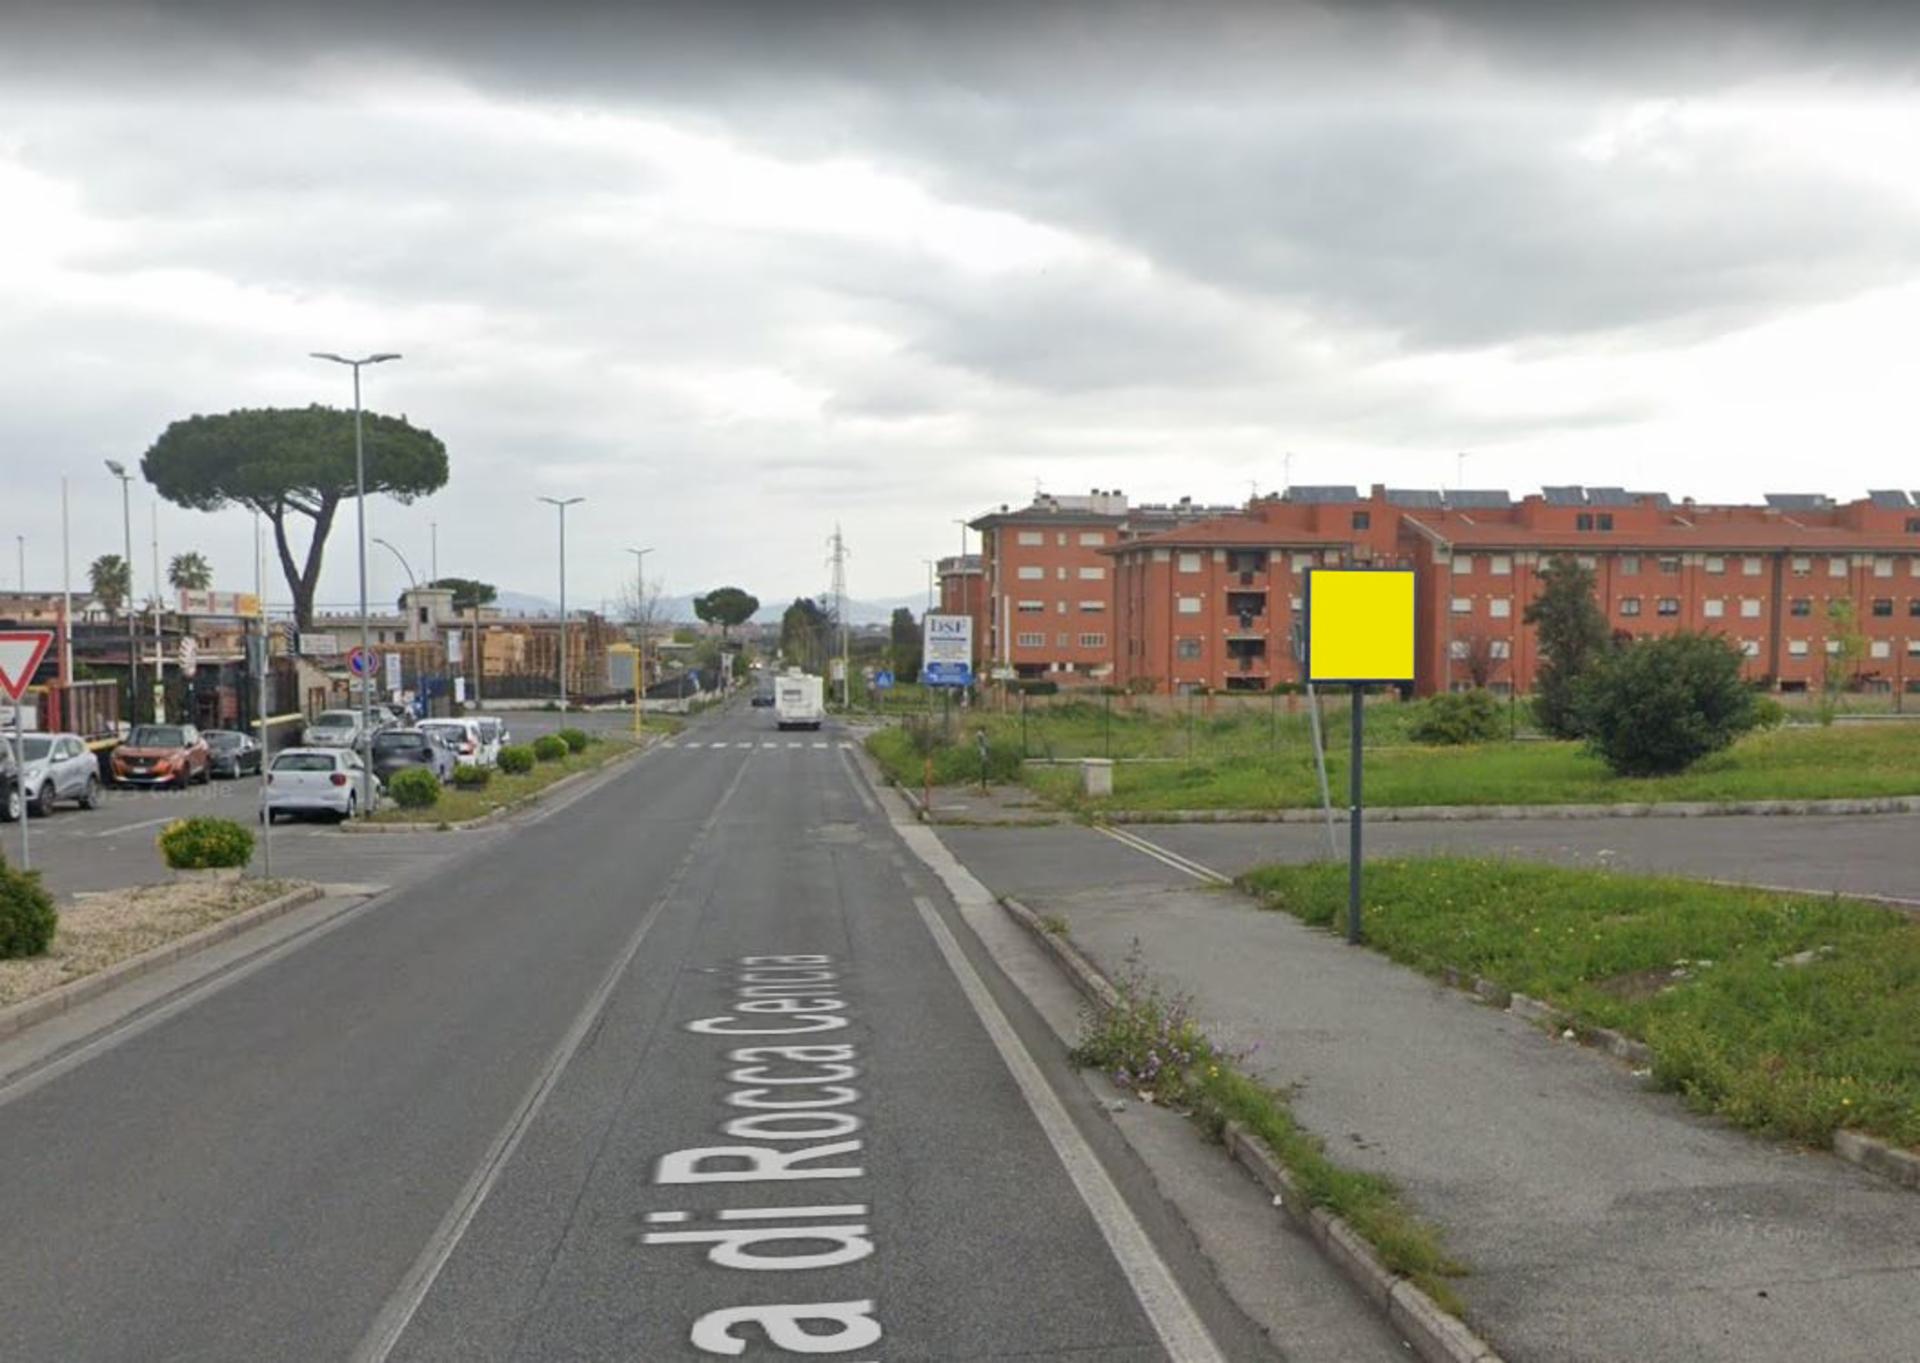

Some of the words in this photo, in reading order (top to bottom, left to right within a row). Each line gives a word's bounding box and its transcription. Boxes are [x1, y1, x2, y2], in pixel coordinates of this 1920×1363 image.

[687, 954, 849, 1035] Cencia
[655, 1043, 866, 1184] Rocca
[643, 1204, 875, 1270] di
[690, 1298, 882, 1363] a
